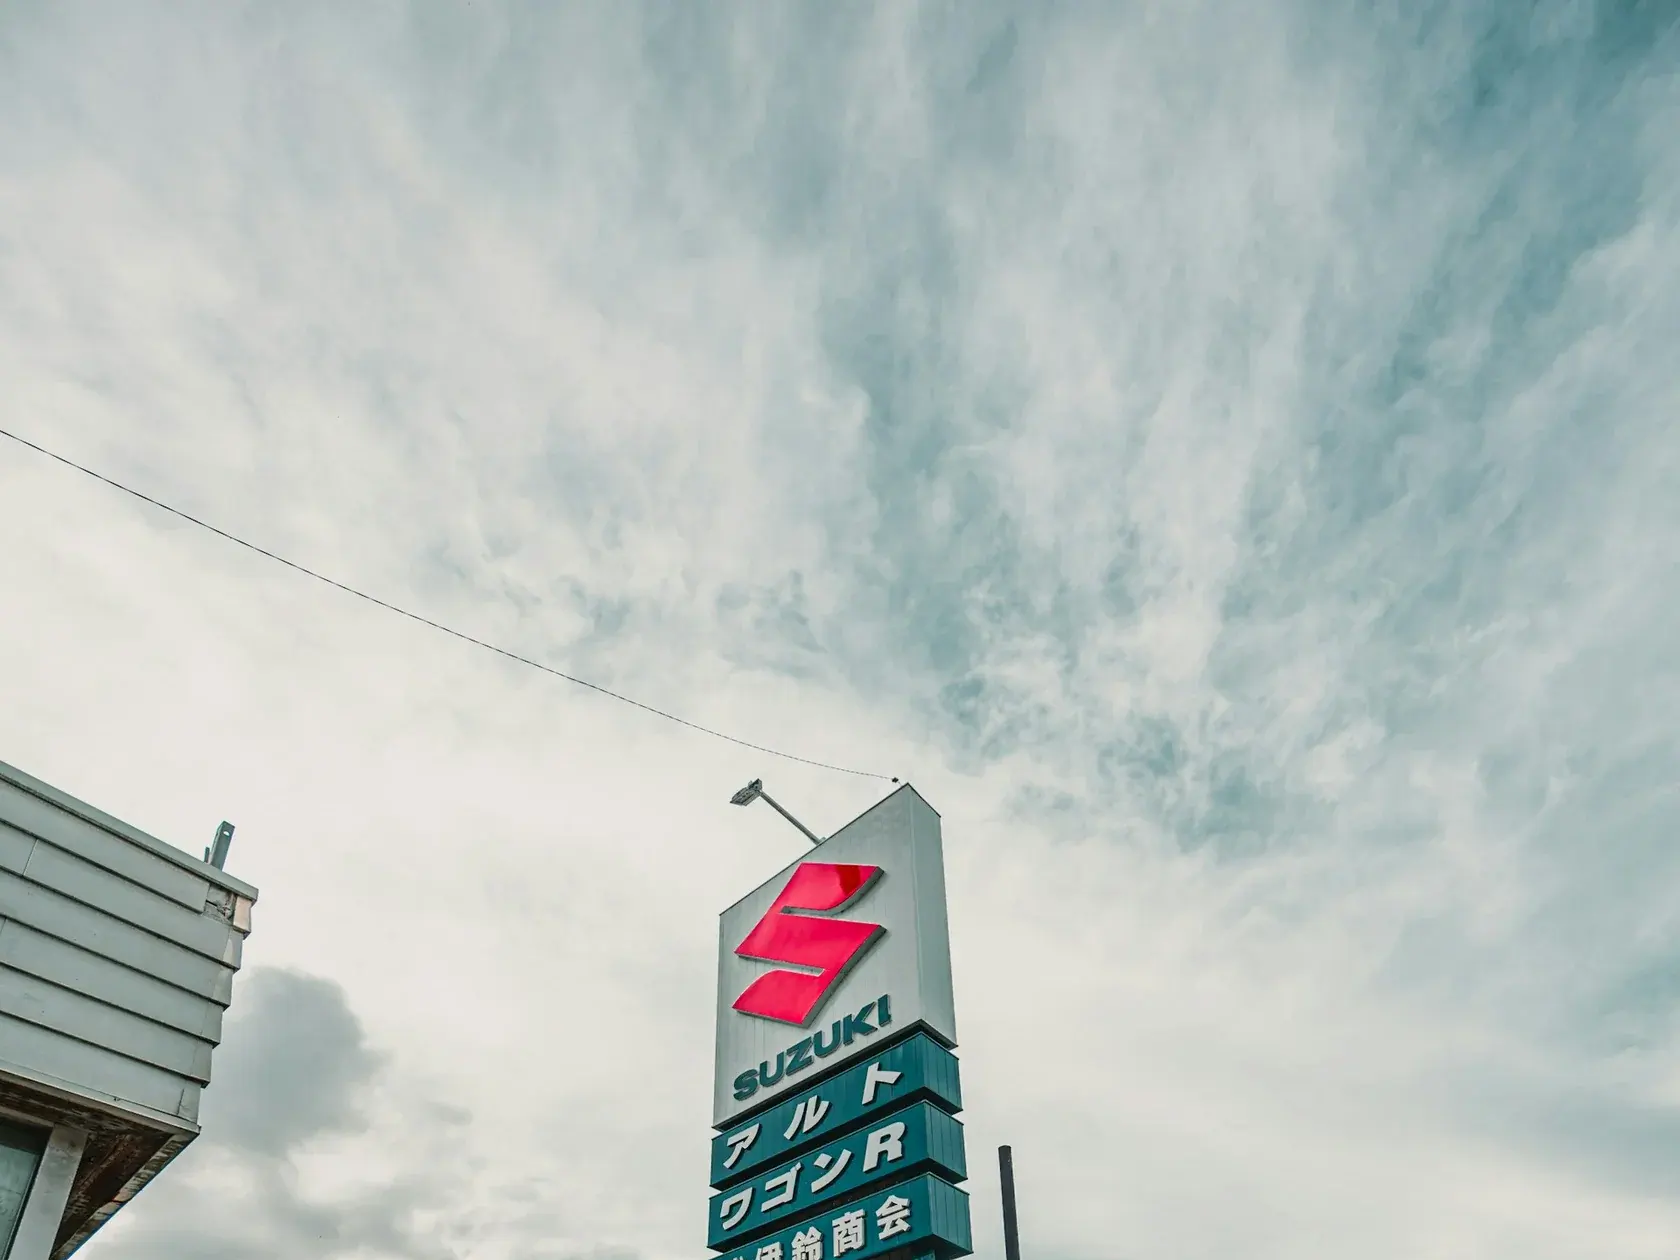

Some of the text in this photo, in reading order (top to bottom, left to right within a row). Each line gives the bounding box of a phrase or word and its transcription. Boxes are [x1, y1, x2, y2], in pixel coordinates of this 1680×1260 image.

[733, 994, 892, 1102] SUZUKI
[723, 1061, 902, 1169] アルト
[720, 1121, 906, 1231] ワゴンR
